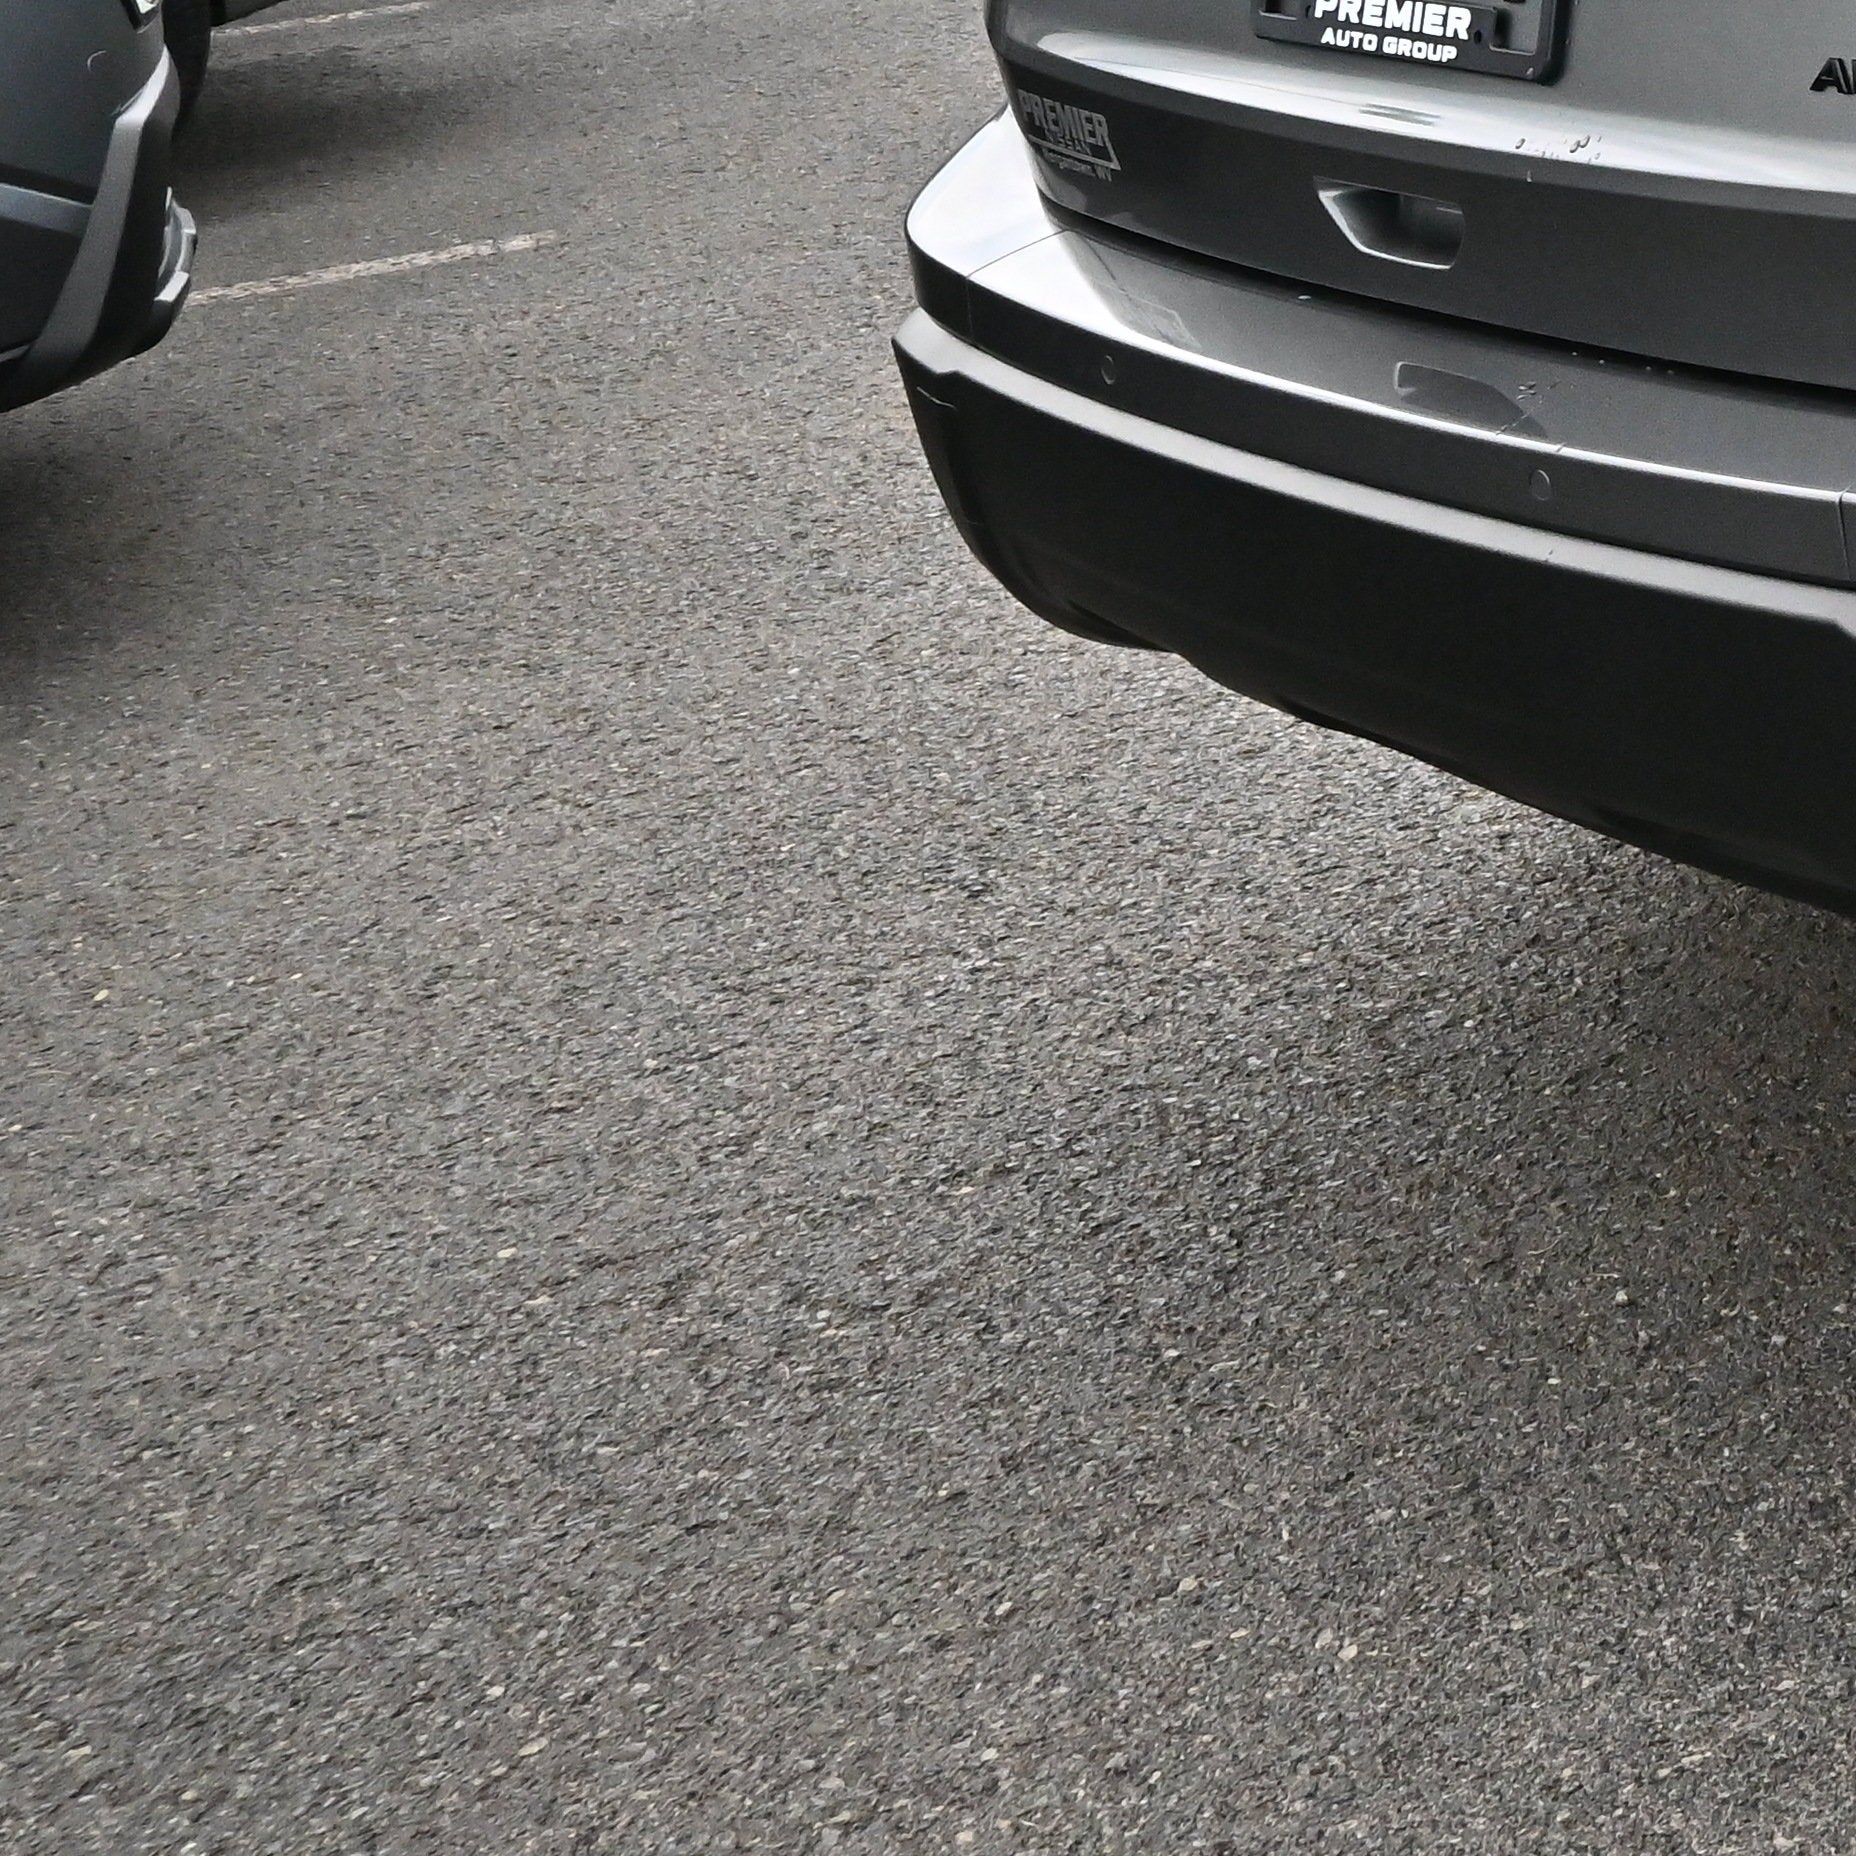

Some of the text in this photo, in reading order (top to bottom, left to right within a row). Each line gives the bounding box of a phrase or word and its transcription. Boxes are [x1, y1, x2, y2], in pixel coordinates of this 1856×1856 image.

[1320, 27, 1458, 63] AUTO GROUP
[1017, 89, 1109, 147] PREMIER
